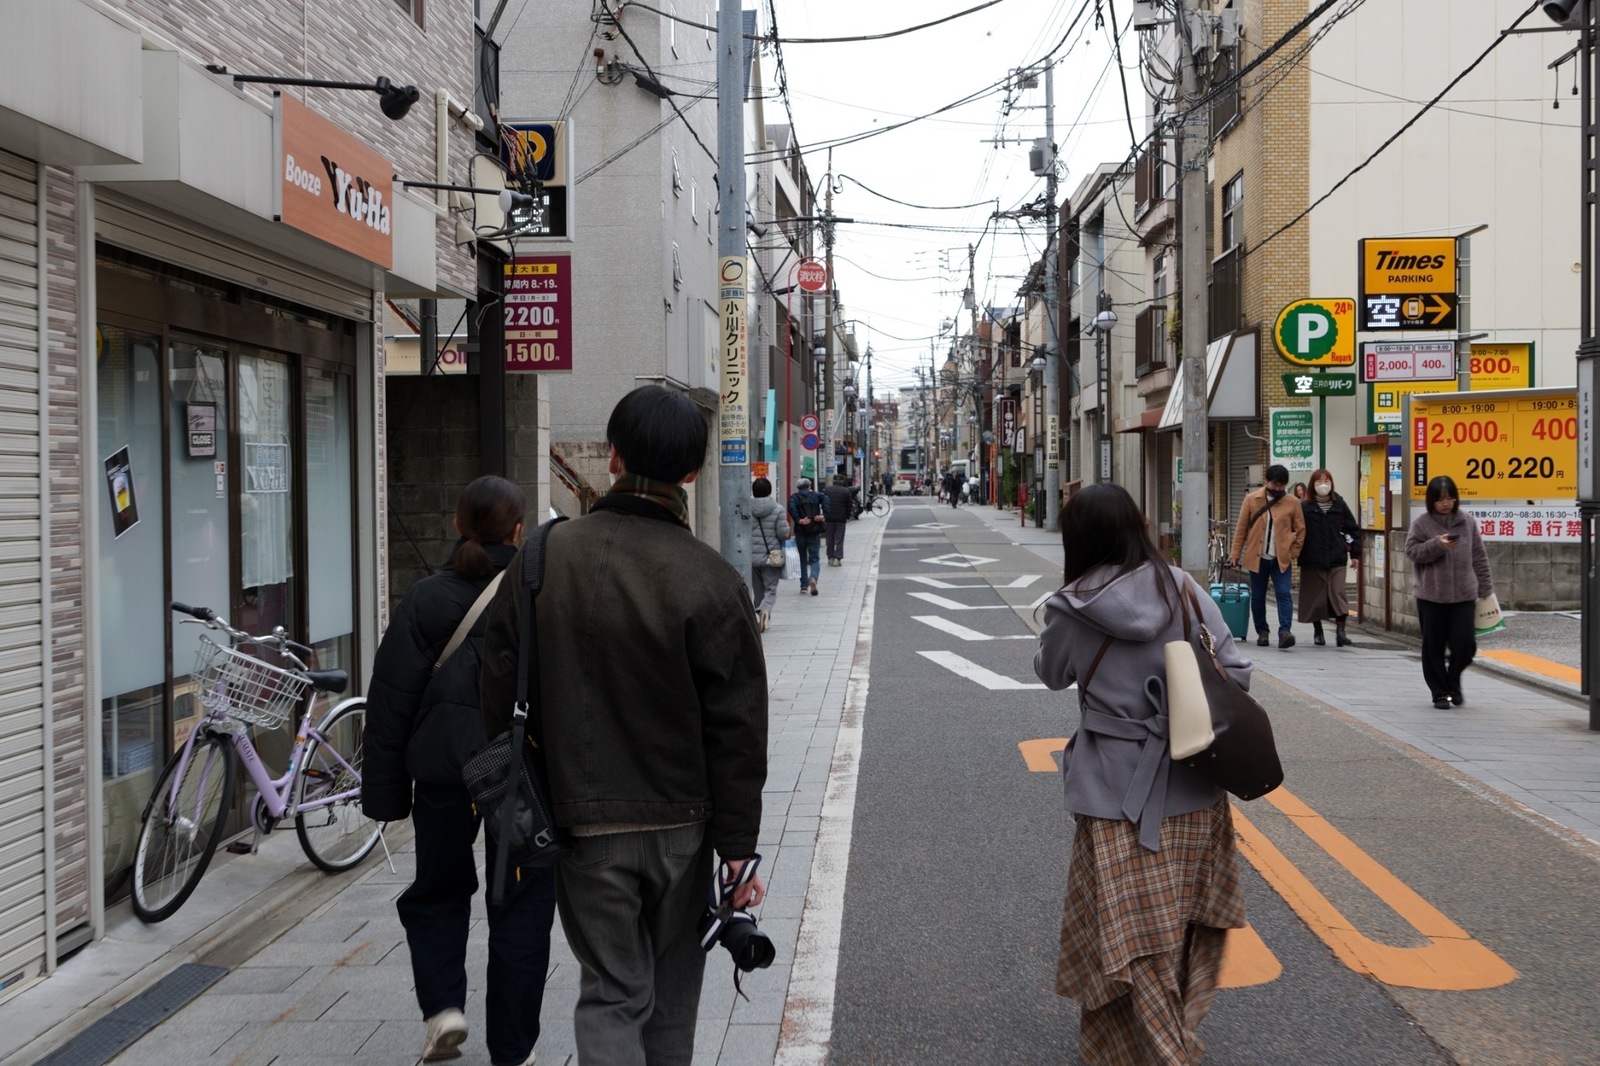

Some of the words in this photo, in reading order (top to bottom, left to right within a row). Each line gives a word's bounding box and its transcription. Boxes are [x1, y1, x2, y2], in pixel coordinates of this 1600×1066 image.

[285, 153, 321, 196] Booze
[331, 163, 390, 235] Yu-Ha
[1376, 250, 1446, 270] Times
[799, 270, 825, 283] 消火栓
[1388, 274, 1434, 283] PARKING
[1334, 302, 1353, 315] 24h
[1367, 294, 1400, 328] 空
[1297, 313, 1329, 354] P
[726, 301, 740, 404] 小川クリニック
[1331, 352, 1352, 363] Repark
[1294, 375, 1313, 393] 空
[1442, 405, 1461, 414] 8:00
[1471, 403, 1496, 412] 19:00
[1532, 400, 1558, 409] 19:00
[805, 419, 816, 427] 30
[1531, 417, 1577, 441] 400
[192, 434, 212, 445] CLOSE
[1480, 520, 1515, 537] 道路
